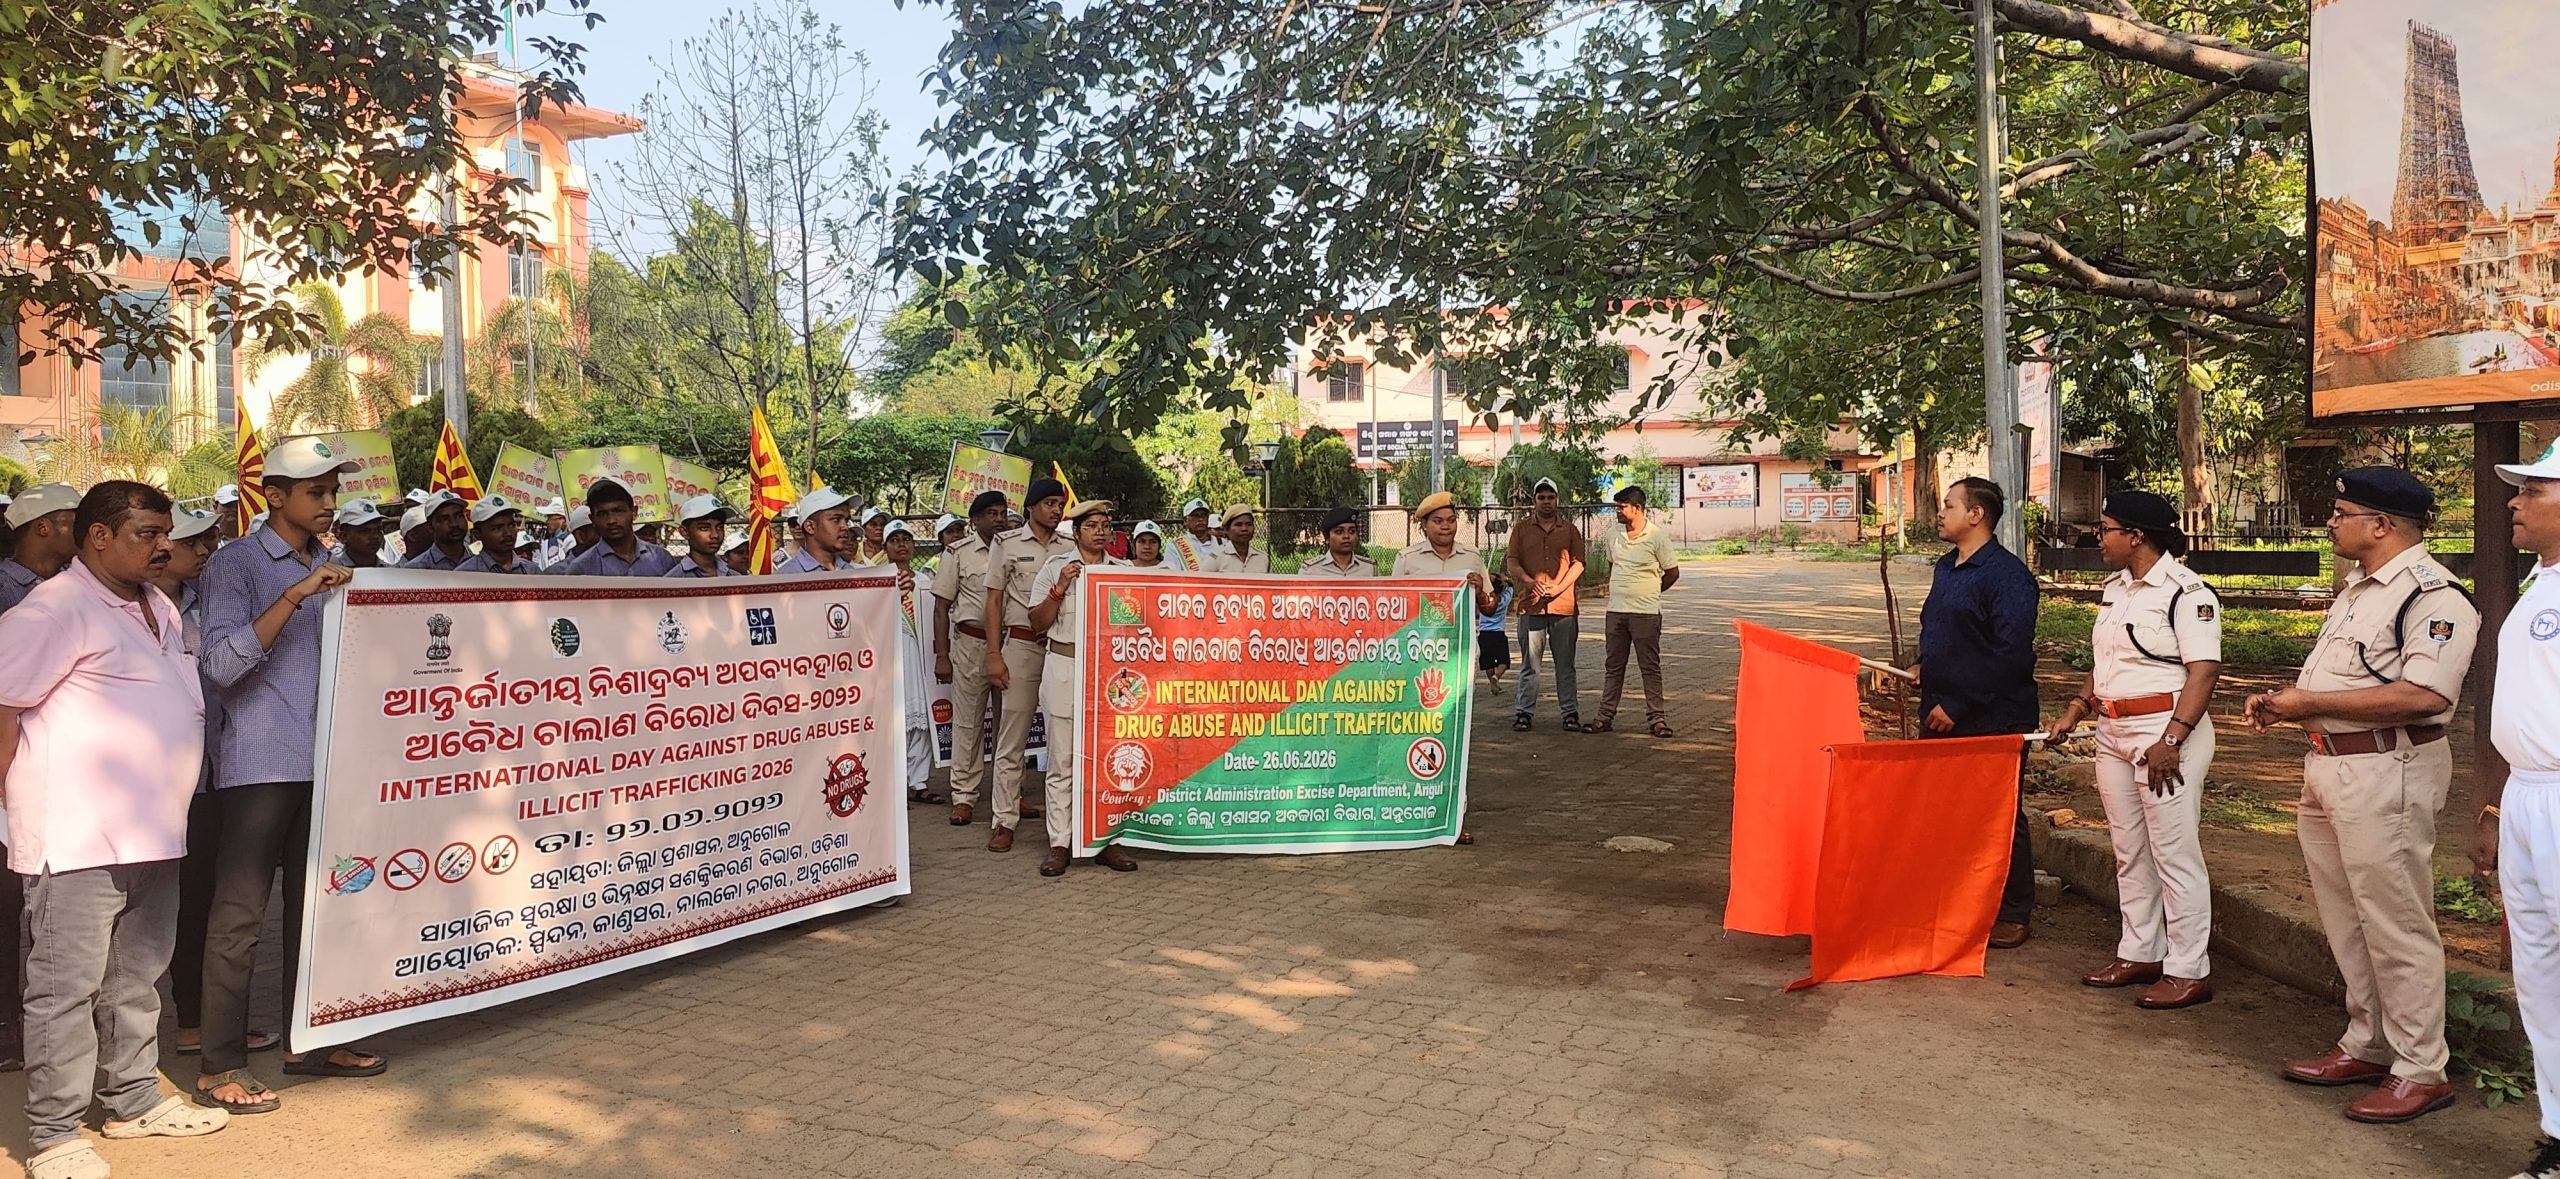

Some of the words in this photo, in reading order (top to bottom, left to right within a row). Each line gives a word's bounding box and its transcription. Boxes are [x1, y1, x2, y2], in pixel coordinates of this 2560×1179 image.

[1157, 593, 1207, 620] ମାଦକ
[1212, 593, 1266, 624] ଦ୍ରବ୍ୟର
[1271, 595, 1371, 626] ଅପବ୍ୟବହାର
[1376, 595, 1408, 620] ତଥା
[1111, 627, 1166, 662] ଅବୈଧ
[1172, 636, 1242, 664] କାରବାର
[1313, 630, 1403, 666] ଆନ୍ତର୍ଜାତୀୟ
[1407, 630, 1450, 662] ଦିବସ
[383, 671, 583, 721] ଆନ୍ତର୍ଜାତୀୟ
[589, 666, 709, 698] ନିଶାଦ୍ରବ୍ୟ
[716, 651, 854, 685] ଅପବ୍ୟବହାର
[857, 649, 874, 669] ଓ
[1155, 680, 1291, 705] INTERNATIONAL
[1295, 679, 1329, 703] DAY
[1332, 679, 1407, 703] AGAINST
[405, 720, 524, 762] ଅବୈଧ
[533, 713, 637, 746] ଚାଲାଣ
[644, 701, 736, 732] ବିରୋଧ
[742, 685, 861, 719] ଦିବସ-୨୦୨୬
[1114, 714, 1164, 739] DRUG
[1168, 713, 1226, 738] ABUSE
[1230, 713, 1266, 737] AND
[1270, 712, 1329, 736] ILLICIT
[1334, 711, 1444, 736] TRAFFICKING
[380, 756, 605, 803] INTERNATIONAL
[611, 748, 656, 772] DAY
[660, 734, 748, 764] AGAINST
[753, 727, 802, 750] DRUG
[805, 717, 860, 741] ABUSE
[863, 716, 875, 731] &
[1224, 751, 1259, 771] Date-
[1263, 750, 1337, 771] 26.06.2026
[519, 790, 604, 820] ILLICIT
[610, 765, 747, 804] TRAFFICKING
[751, 758, 793, 779] 2026
[827, 783, 839, 798] NO
[839, 771, 864, 793] DRUGS
[1157, 787, 1202, 803] District
[1205, 786, 1293, 802] Administration
[1296, 784, 1335, 800] Excise
[1339, 783, 1411, 801] Department,
[1414, 781, 1444, 800] Angul
[607, 792, 784, 841] ୨୬.୦୬.୨୦୨୬
[1107, 810, 1174, 826] ଆୟୋଜକ
[1187, 807, 1216, 829] ଜିଲ୍ଲା
[1220, 810, 1271, 827] ପ୍ରଶାସନ
[1276, 808, 1329, 823] ଅବକାରୀ
[1381, 805, 1437, 824] ଅନୁଗୋଳ
[347, 863, 368, 879] DRUGS
[530, 860, 613, 891] ସହାୟତା:
[617, 848, 657, 875] ଜିଲ୍ଲା
[661, 836, 722, 866] ପ୍ରଶାସନ,
[727, 821, 792, 853] ଅନୁଗୋଳ
[420, 909, 515, 942] ସାମାଜିକ
[521, 895, 577, 930] ସୁରକ୍ଷା
[582, 891, 596, 909] ଓ
[601, 876, 665, 906] ଭିନ୍ନକ୍ଷମ
[811, 831, 849, 855] ଓଡ଼ିଶା
[395, 936, 522, 977] ଆୟୋଜକ:
[677, 881, 741, 914] ନାଲକୋ
[797, 853, 860, 885] ଅନୁଗୋଳ
